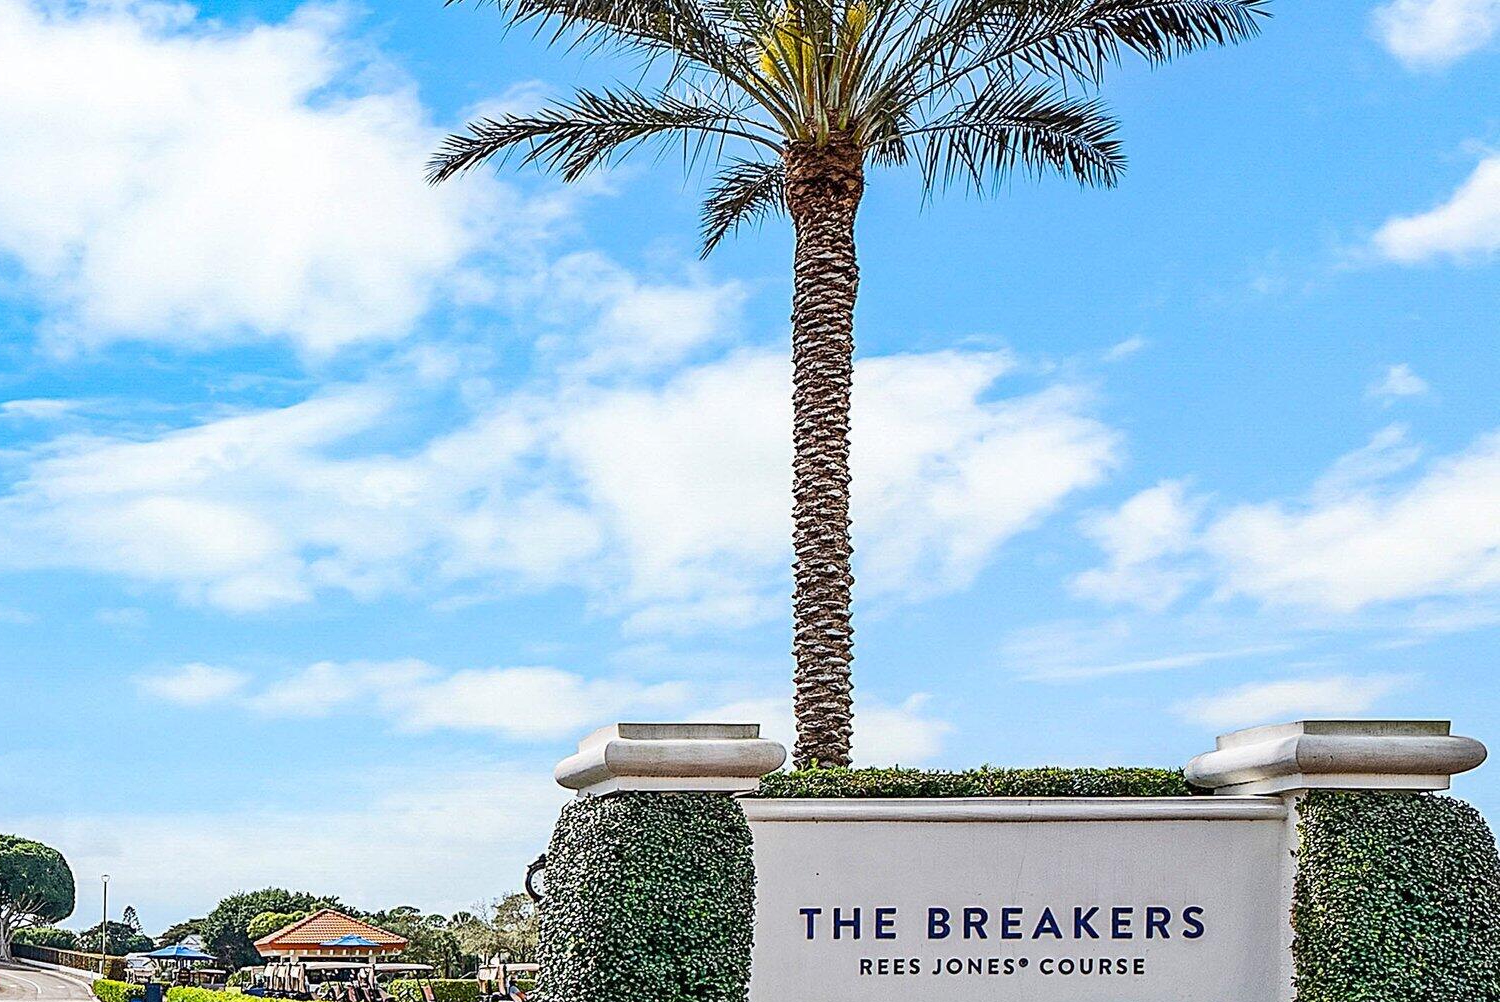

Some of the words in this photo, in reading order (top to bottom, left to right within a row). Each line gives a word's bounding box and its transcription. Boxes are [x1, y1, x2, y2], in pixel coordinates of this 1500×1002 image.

[800, 907, 897, 940] THE
[927, 906, 1205, 940] BREAKERS
[859, 958, 921, 975] REES
[1039, 958, 1146, 975] COURSE
